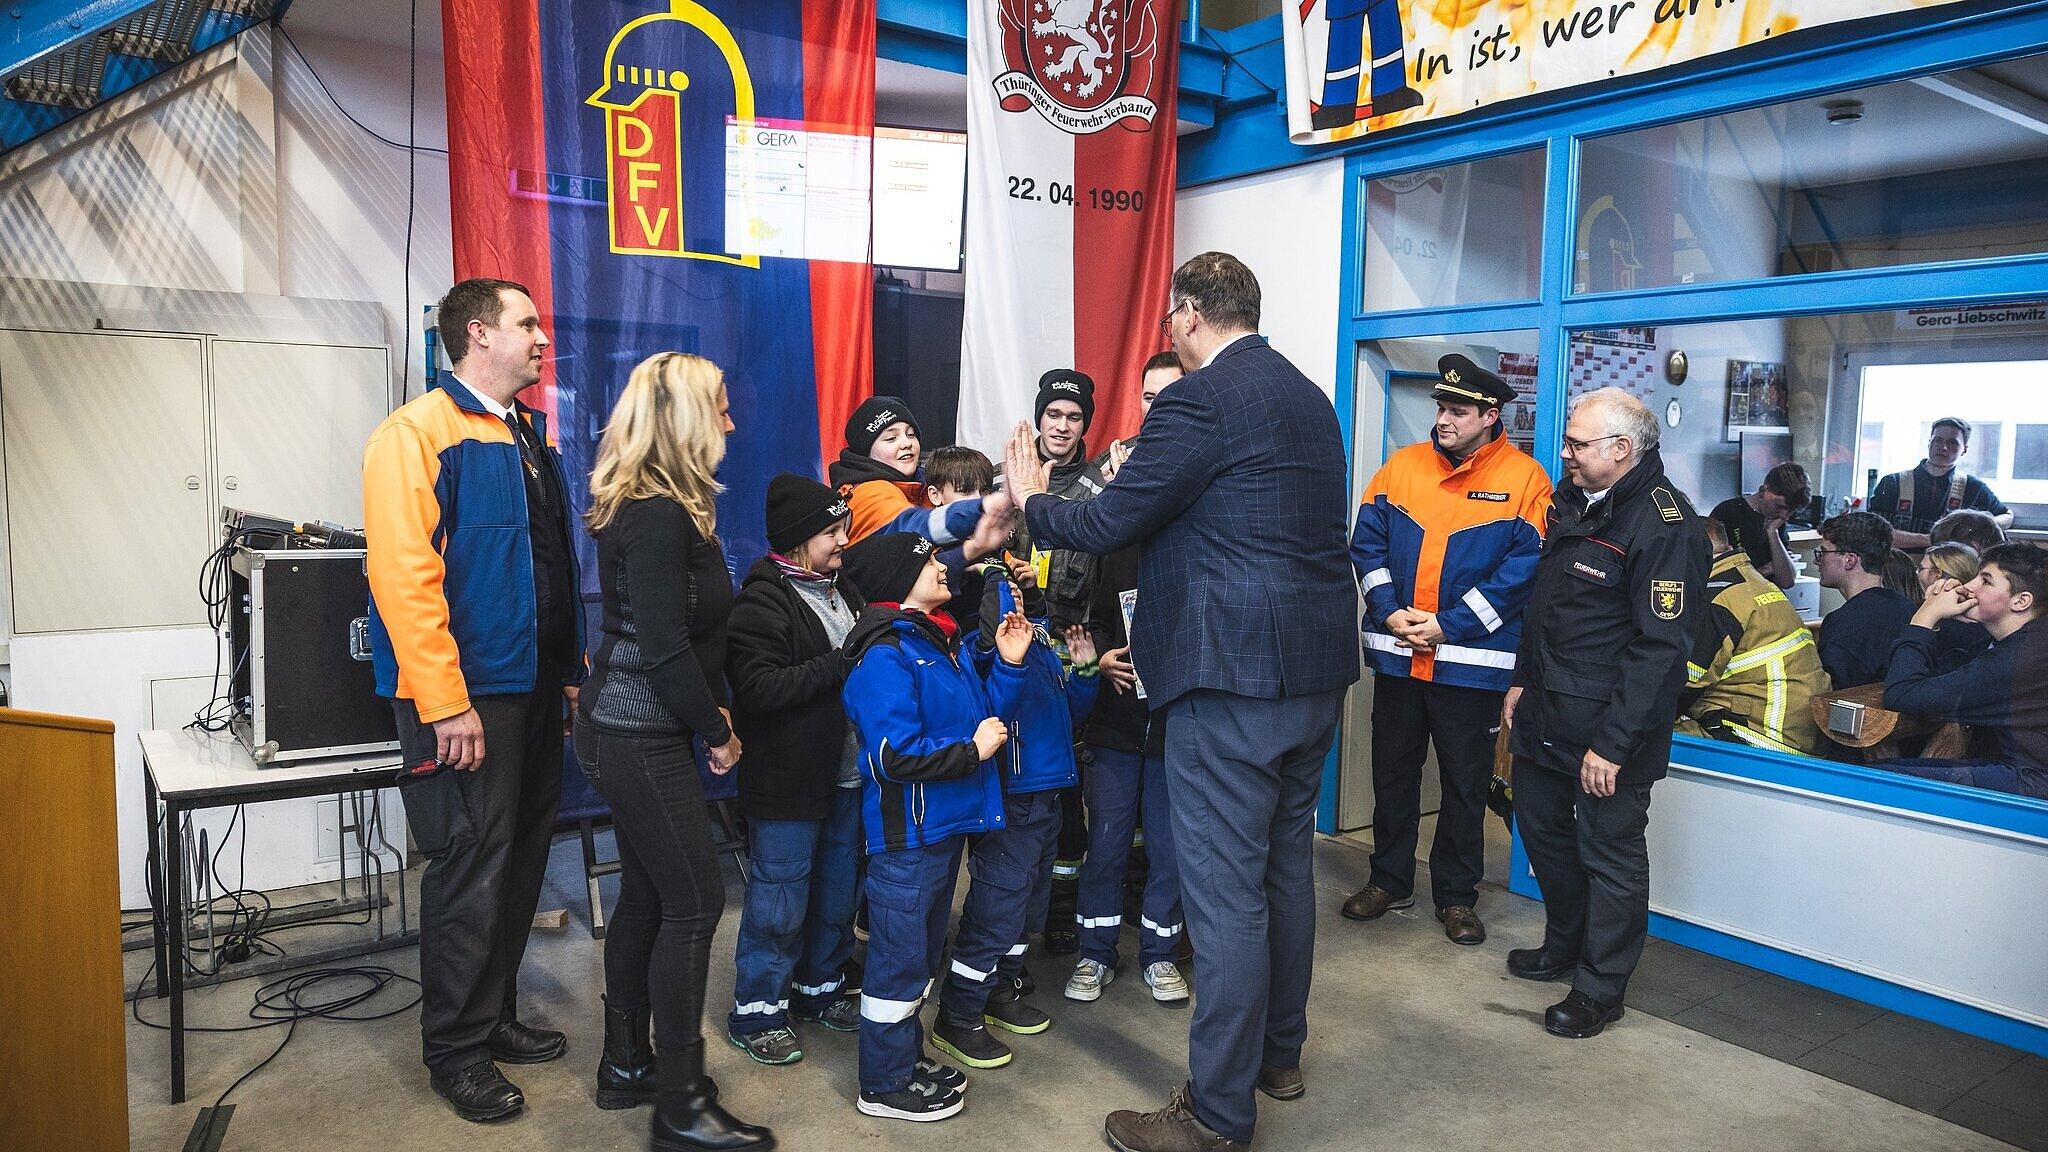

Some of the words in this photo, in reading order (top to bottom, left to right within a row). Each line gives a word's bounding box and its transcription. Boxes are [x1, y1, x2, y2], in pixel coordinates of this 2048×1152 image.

[1415, 48, 1453, 83] In
[1468, 24, 1521, 71] ist,
[1542, 0, 1636, 49] wer
[1000, 76, 1052, 112] Thüringer
[1051, 101, 1153, 129] Feuerwehr-Verband
[757, 131, 798, 147] GERA
[617, 115, 670, 247] DFV
[1008, 175, 1042, 202] 22.
[1049, 181, 1080, 207] 04.
[1088, 187, 1144, 213] 1990
[1916, 308, 2046, 327] Gera-Liebschwitz
[1573, 561, 1607, 579] FEUERWEHR
